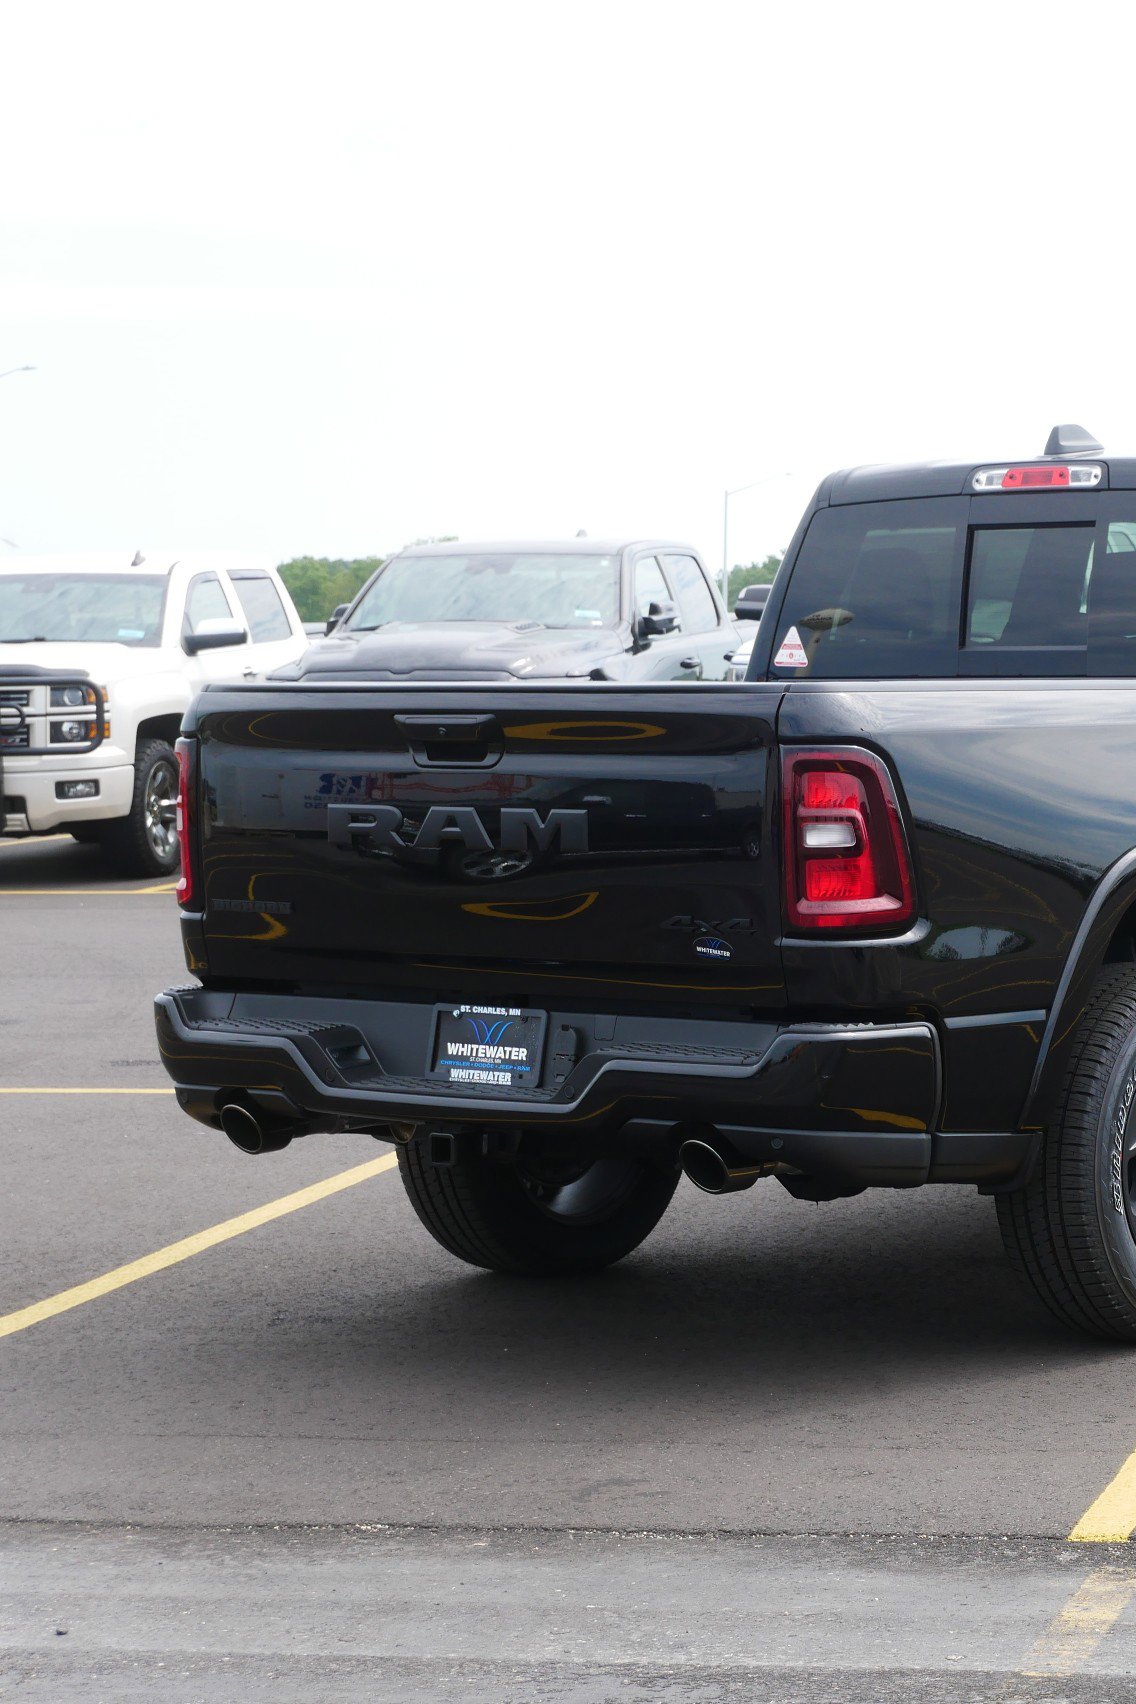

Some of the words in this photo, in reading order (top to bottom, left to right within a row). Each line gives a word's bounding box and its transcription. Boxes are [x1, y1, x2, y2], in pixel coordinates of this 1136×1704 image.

[328, 803, 589, 851] RAM
[696, 946, 731, 957] WHITEWATER
[472, 1006, 507, 1015] CHARLES,
[447, 1042, 527, 1060] WHITEWATER
[450, 1068, 511, 1081] WHITEWATER
